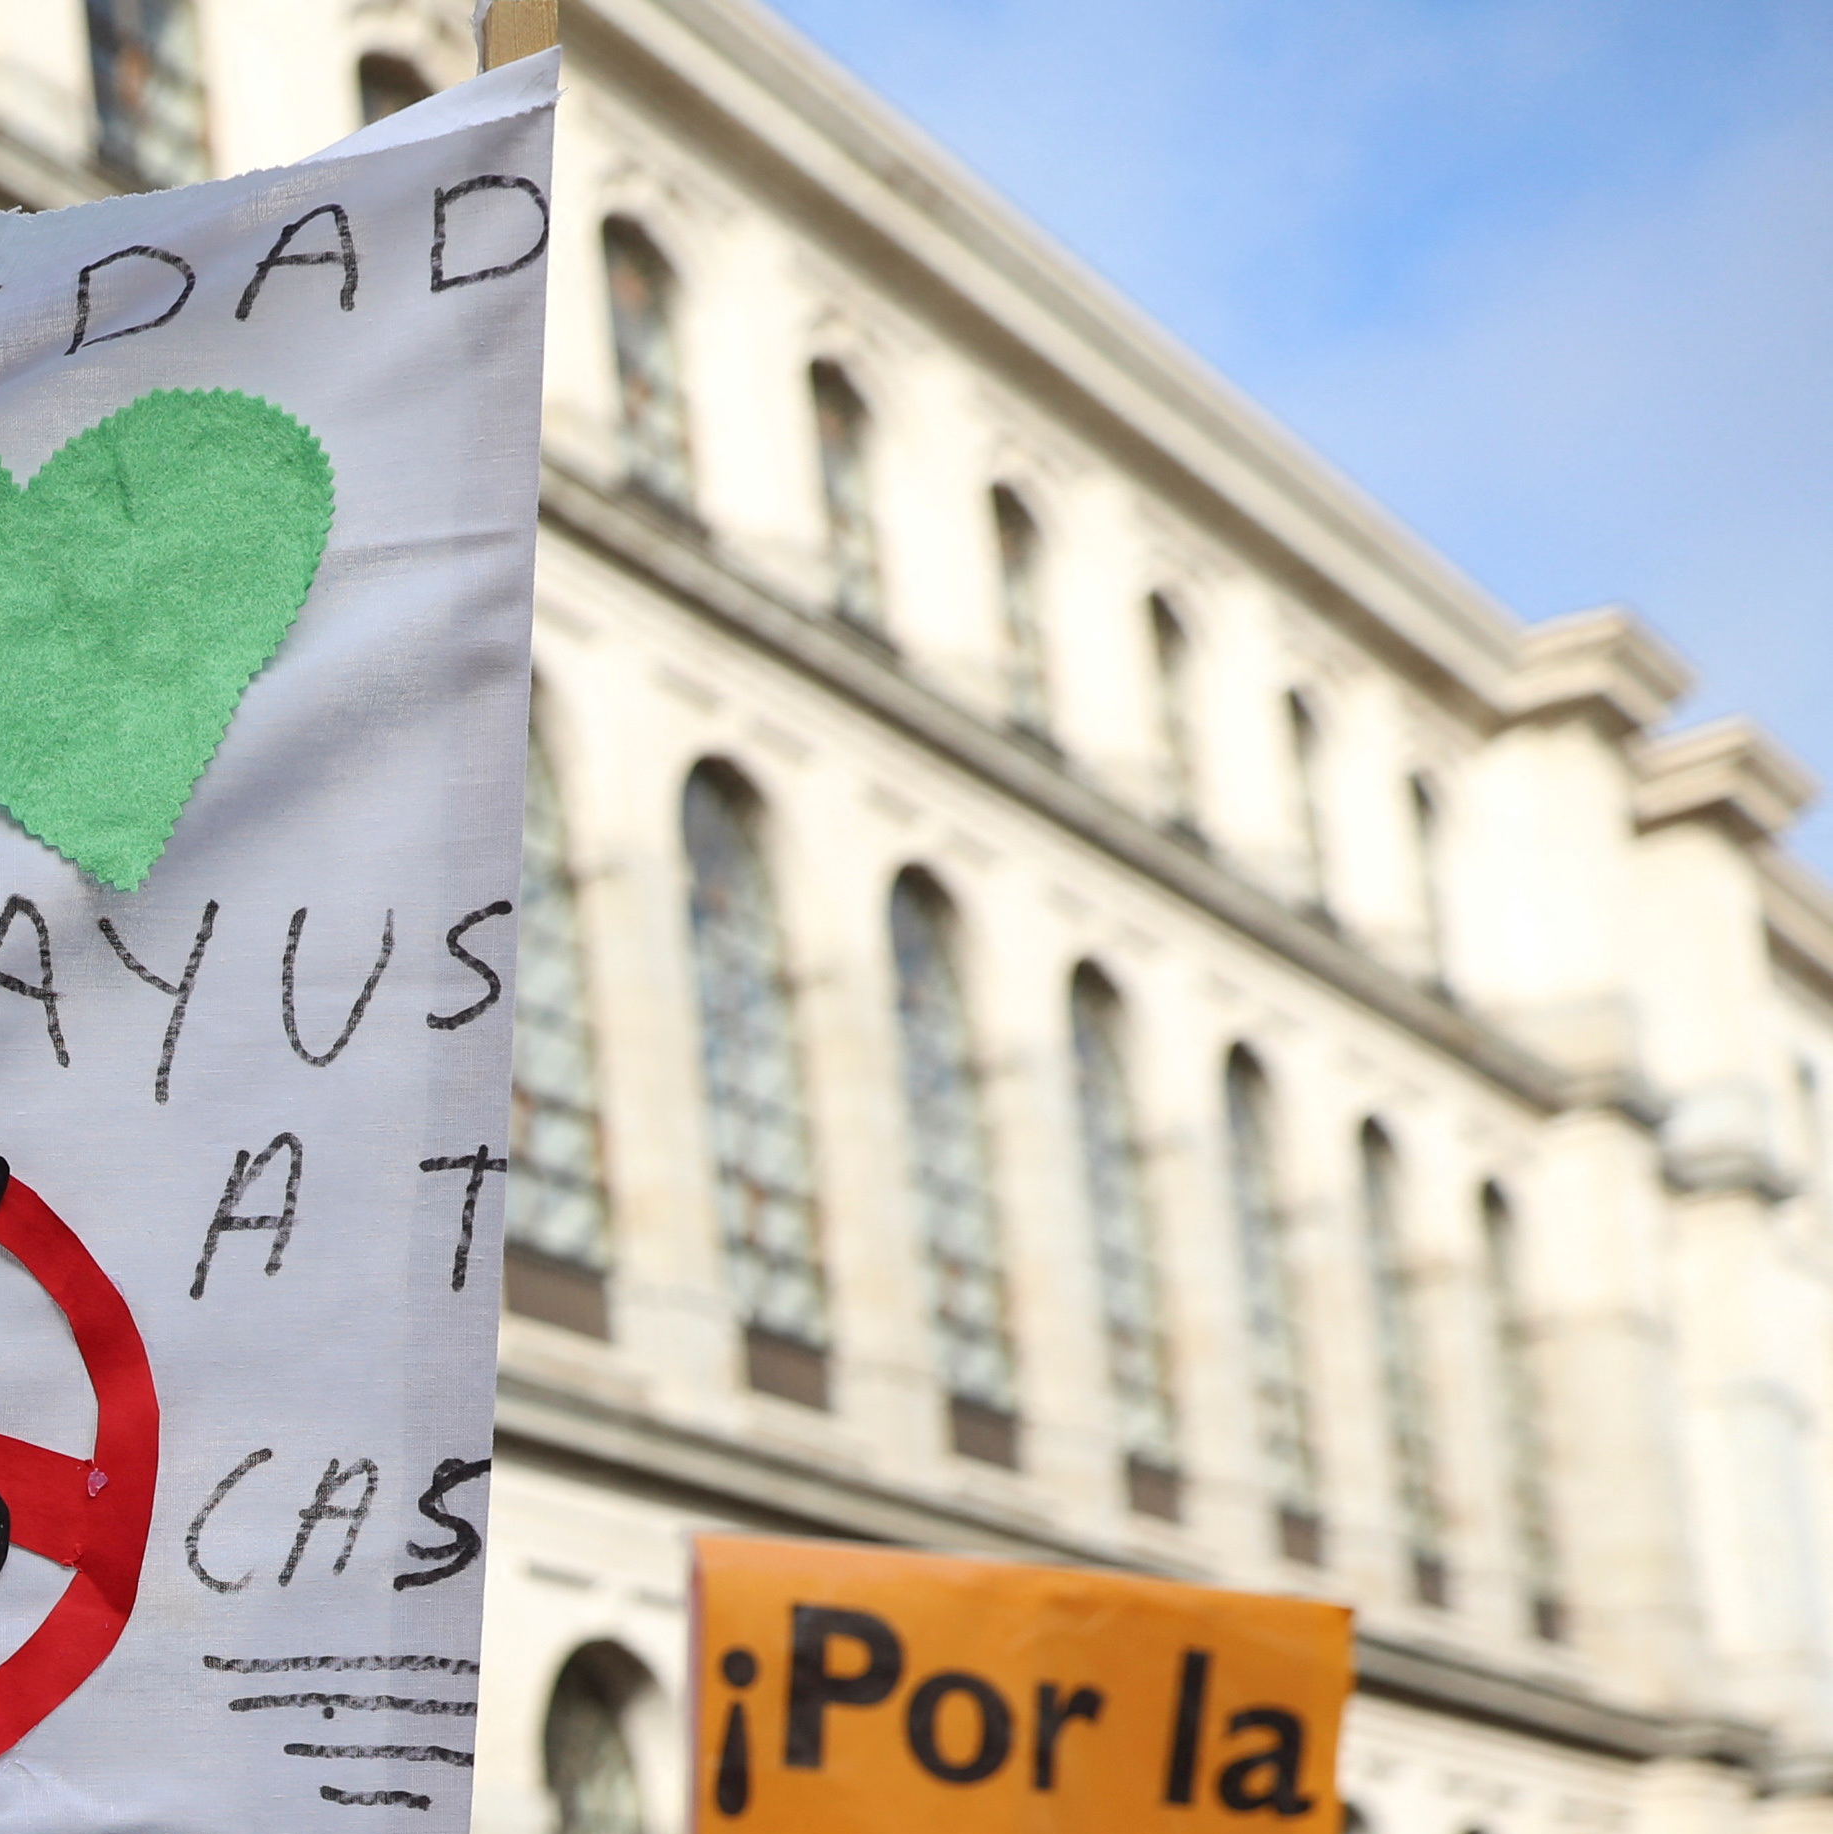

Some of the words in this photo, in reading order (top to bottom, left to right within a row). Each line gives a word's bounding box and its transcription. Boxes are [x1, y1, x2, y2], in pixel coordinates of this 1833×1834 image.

[188, 1130, 304, 1301] A
[714, 1604, 1102, 1819] ¡Por
[1160, 1647, 1316, 1821] la
